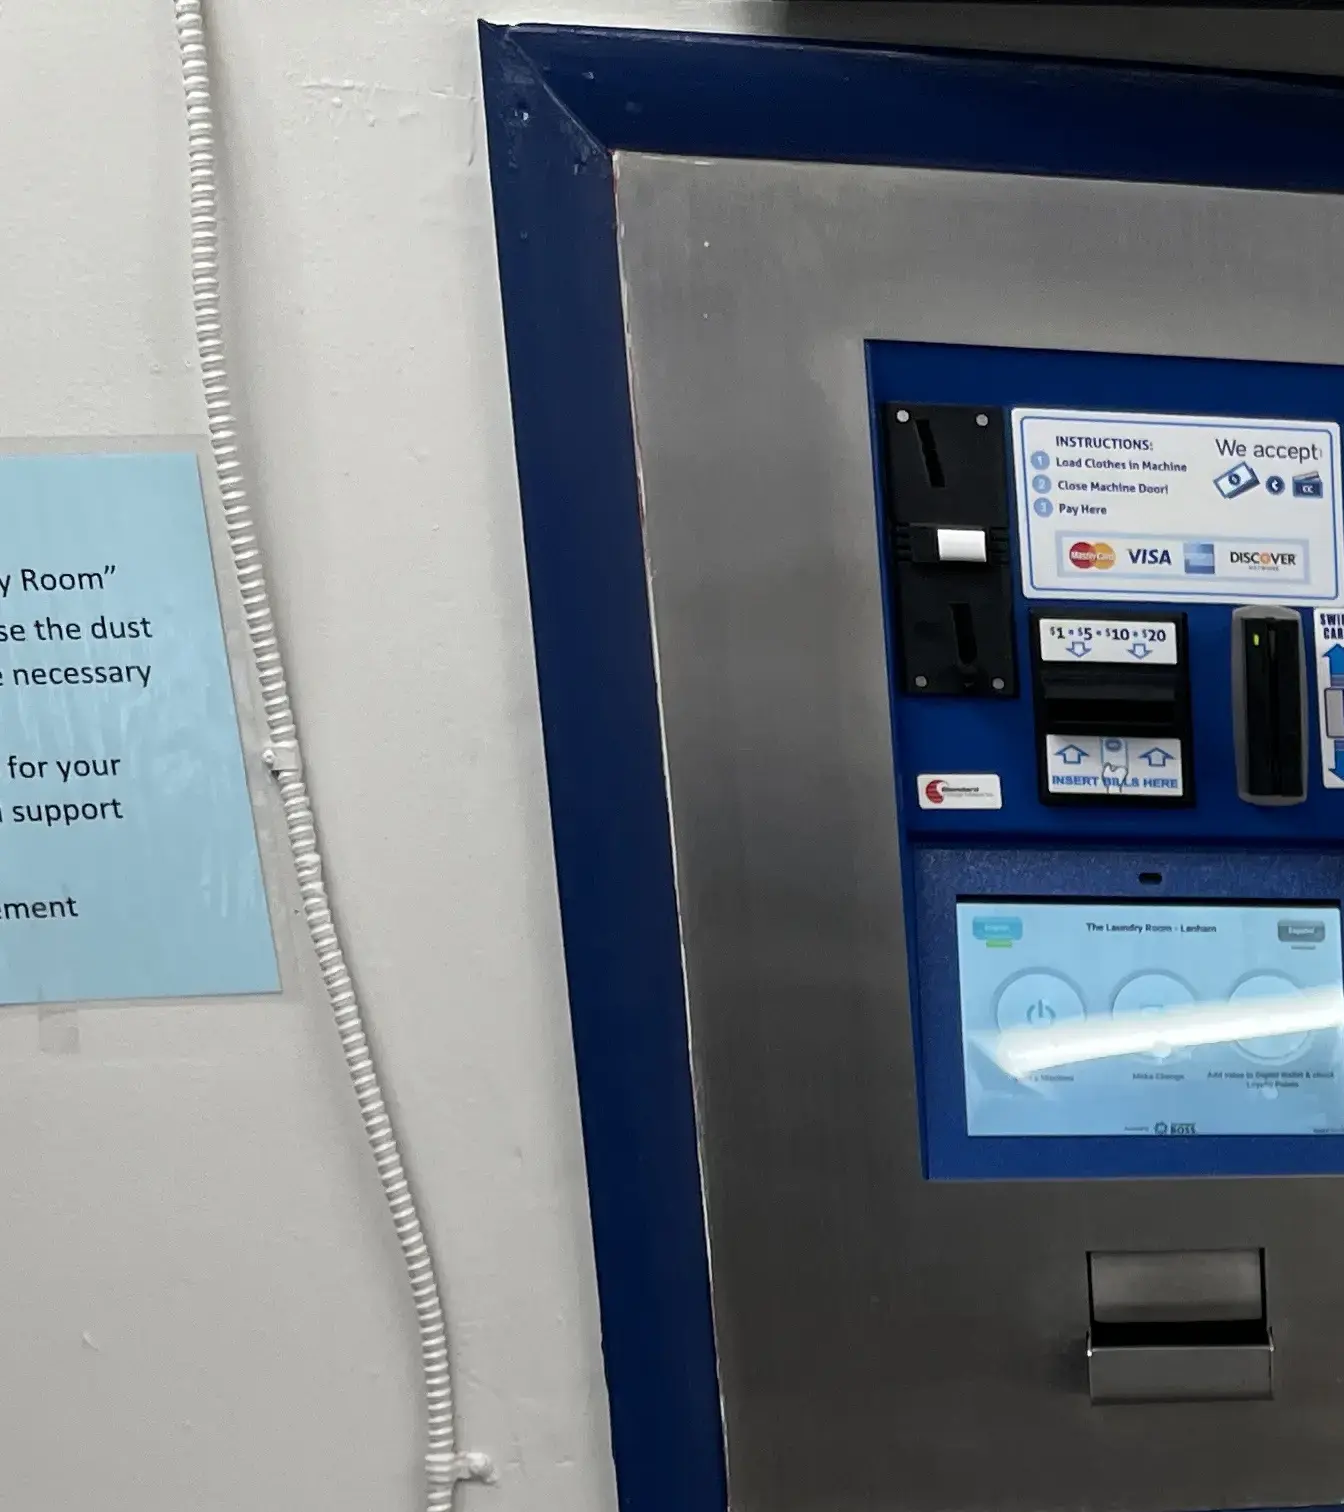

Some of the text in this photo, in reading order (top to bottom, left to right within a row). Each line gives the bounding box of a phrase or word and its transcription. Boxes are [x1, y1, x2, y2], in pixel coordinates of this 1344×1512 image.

[1055, 435, 1154, 451] INSTRUCTIONS:
[1214, 438, 1247, 459] We
[1055, 456, 1083, 469] Load
[1084, 457, 1127, 471] Clothes
[1128, 459, 1140, 471] in
[1142, 459, 1188, 473] Machine
[1057, 480, 1088, 492] Close
[1090, 480, 1137, 494] Machine
[1058, 503, 1079, 517] Pay
[1080, 504, 1108, 516] Here
[1127, 548, 1172, 566] VISA
[1229, 550, 1297, 566] DISCOVER
[33, 616, 82, 642] the
[90, 615, 154, 640] dust
[1049, 626, 1167, 643] $1 $5 $10 $20
[12, 664, 152, 688] necessary
[6, 754, 121, 783] for your
[1051, 775, 1100, 788] INSERT
[1142, 777, 1179, 789] HERE
[12, 797, 124, 827] support
[0, 896, 79, 921] ment
